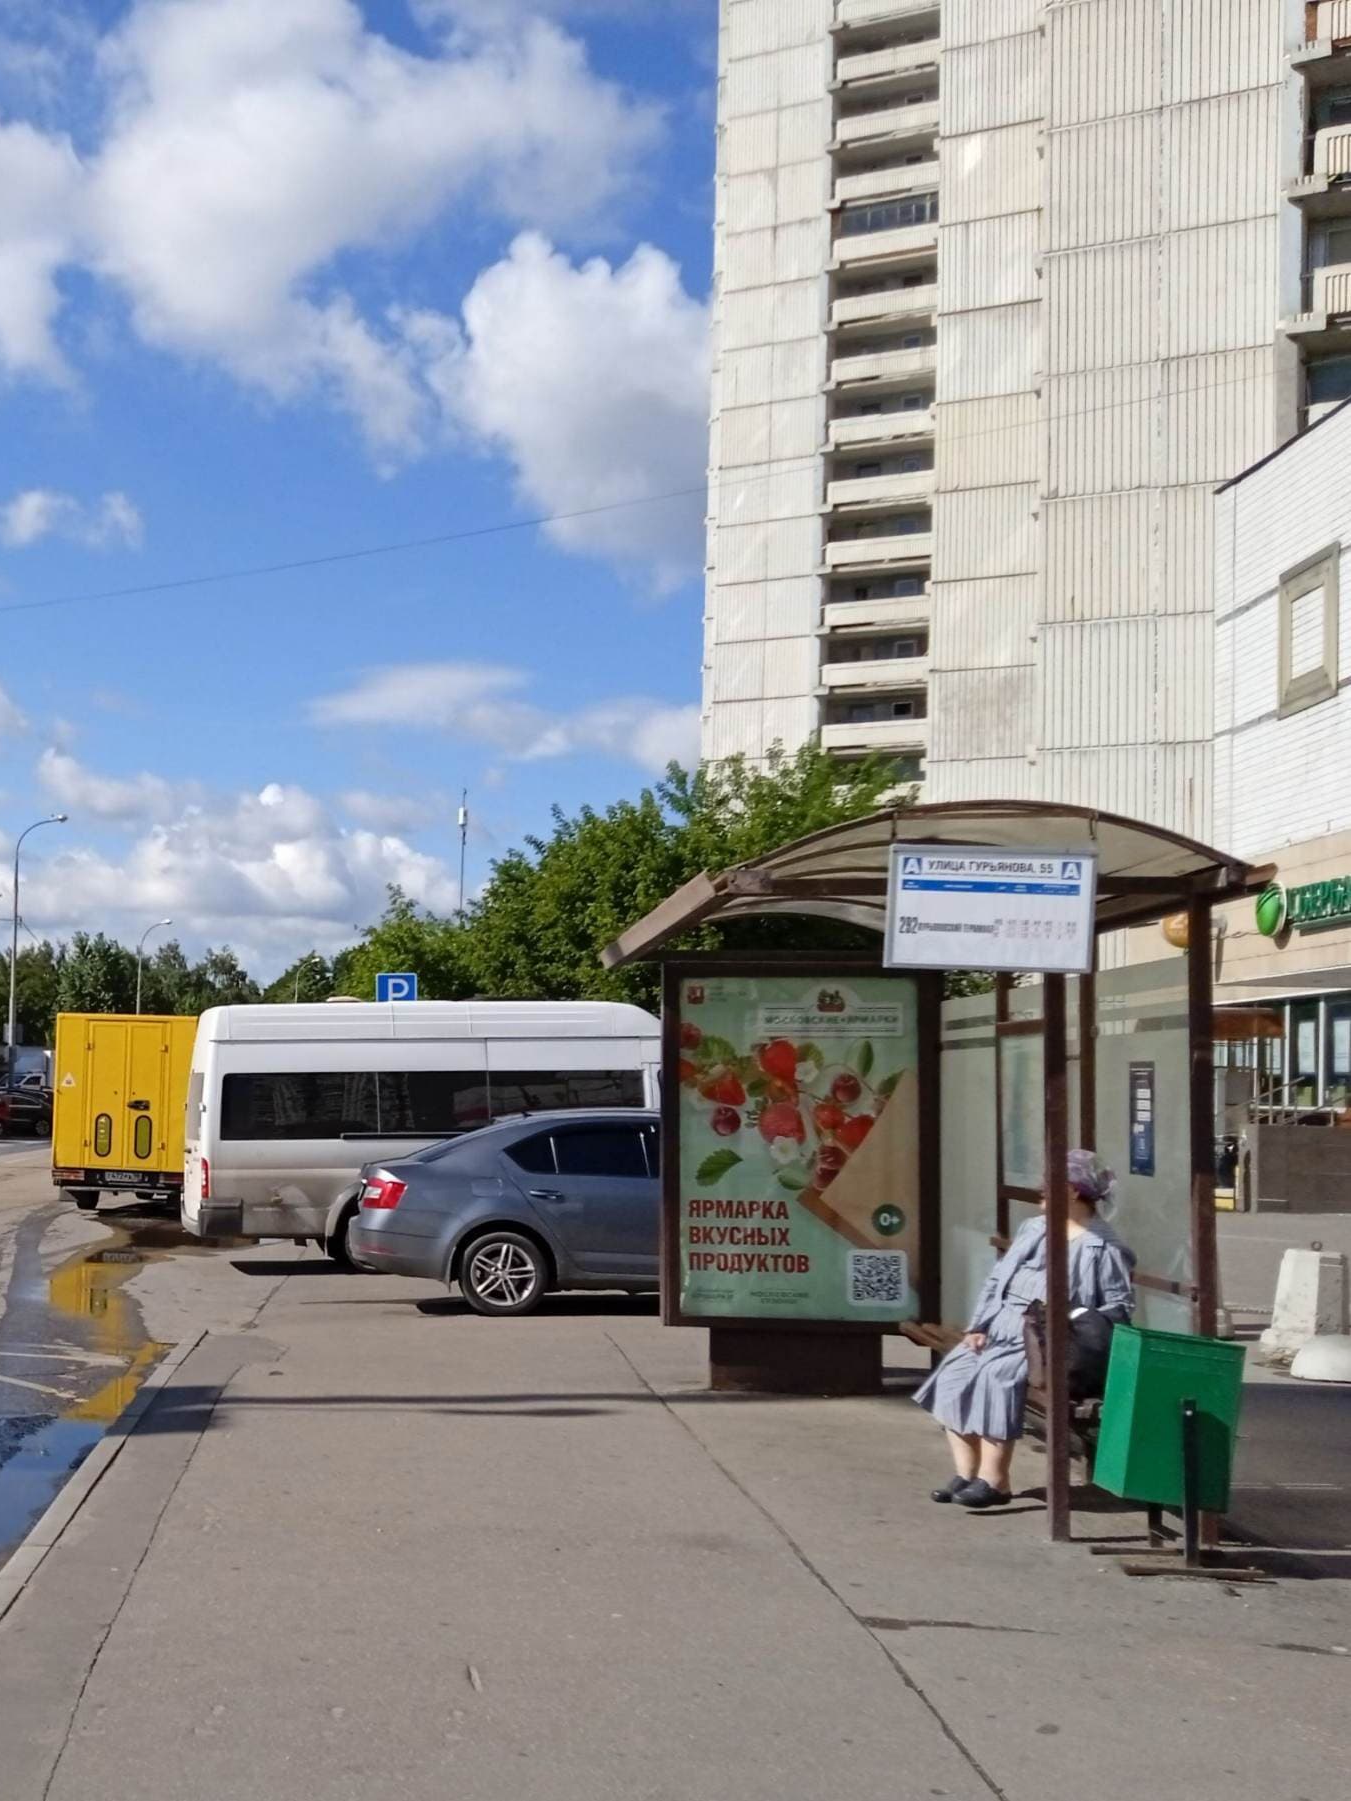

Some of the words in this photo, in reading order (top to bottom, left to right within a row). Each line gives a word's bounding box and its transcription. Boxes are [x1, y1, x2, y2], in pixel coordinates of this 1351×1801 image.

[928, 860, 966, 872] УЛИЦА
[1040, 863, 1054, 874] 55
[388, 978, 409, 1002] P
[688, 1200, 790, 1220] ЯРМАРКА
[878, 1213, 901, 1226] 0+
[689, 1226, 791, 1246] ВКУСНЫХ
[688, 1252, 810, 1274] ПРОДУКТОВ
